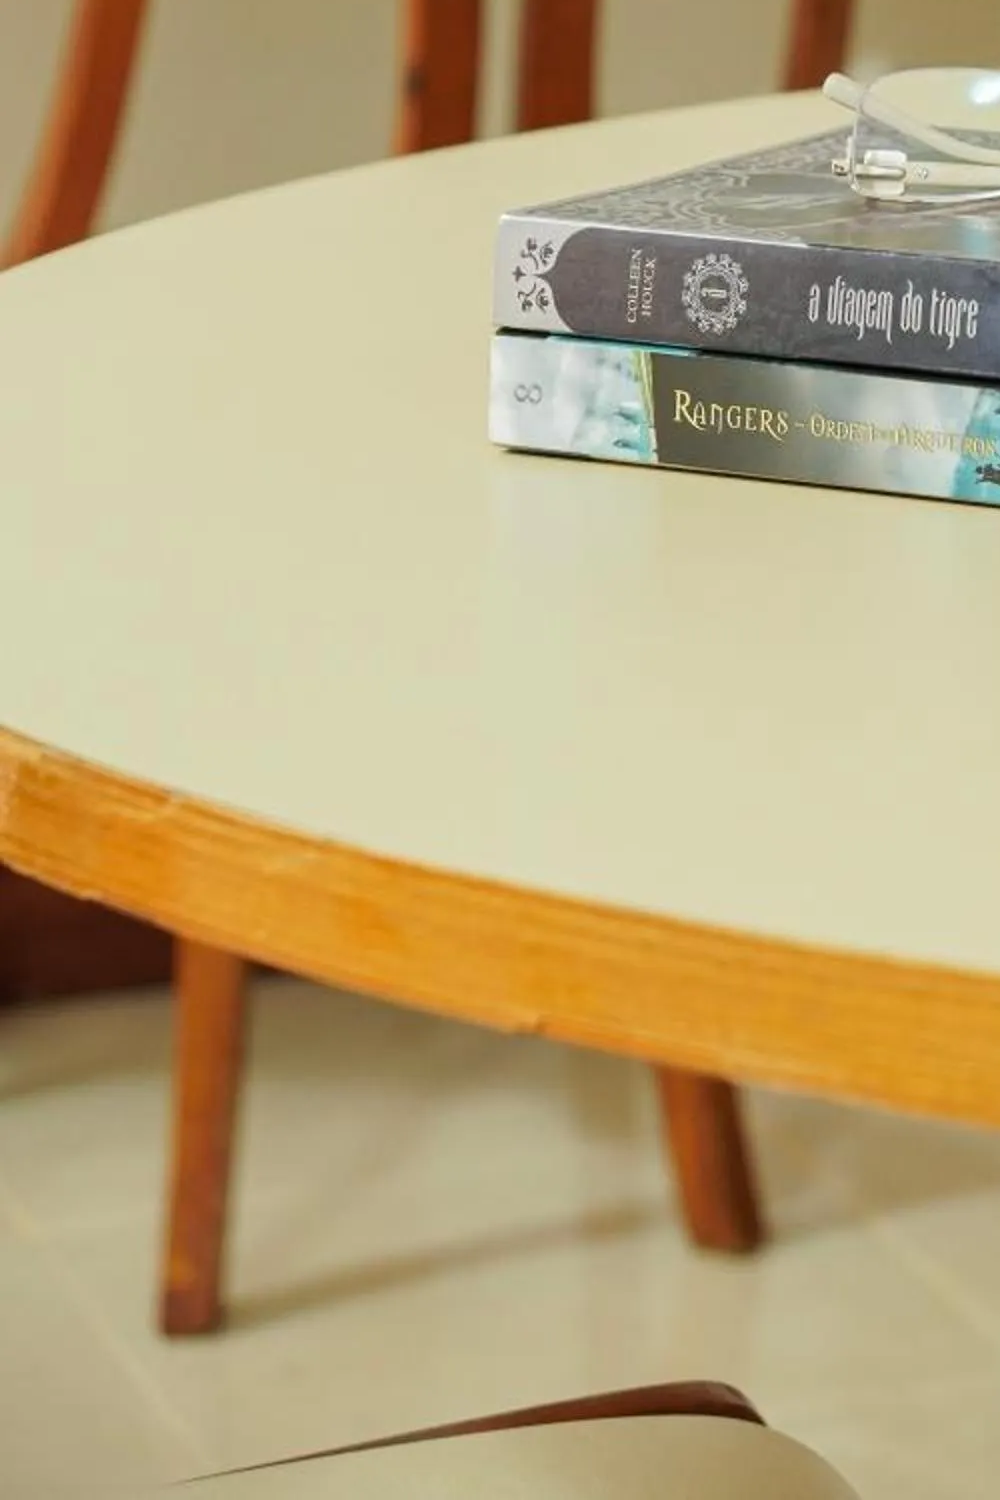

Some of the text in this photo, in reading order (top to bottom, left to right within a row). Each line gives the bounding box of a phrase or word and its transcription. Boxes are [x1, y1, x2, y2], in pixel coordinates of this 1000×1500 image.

[625, 248, 643, 323] COLLEEN
[642, 257, 657, 318] HOUCK
[808, 275, 979, 351] a viagem do tigre
[672, 389, 790, 442] RANGERS
